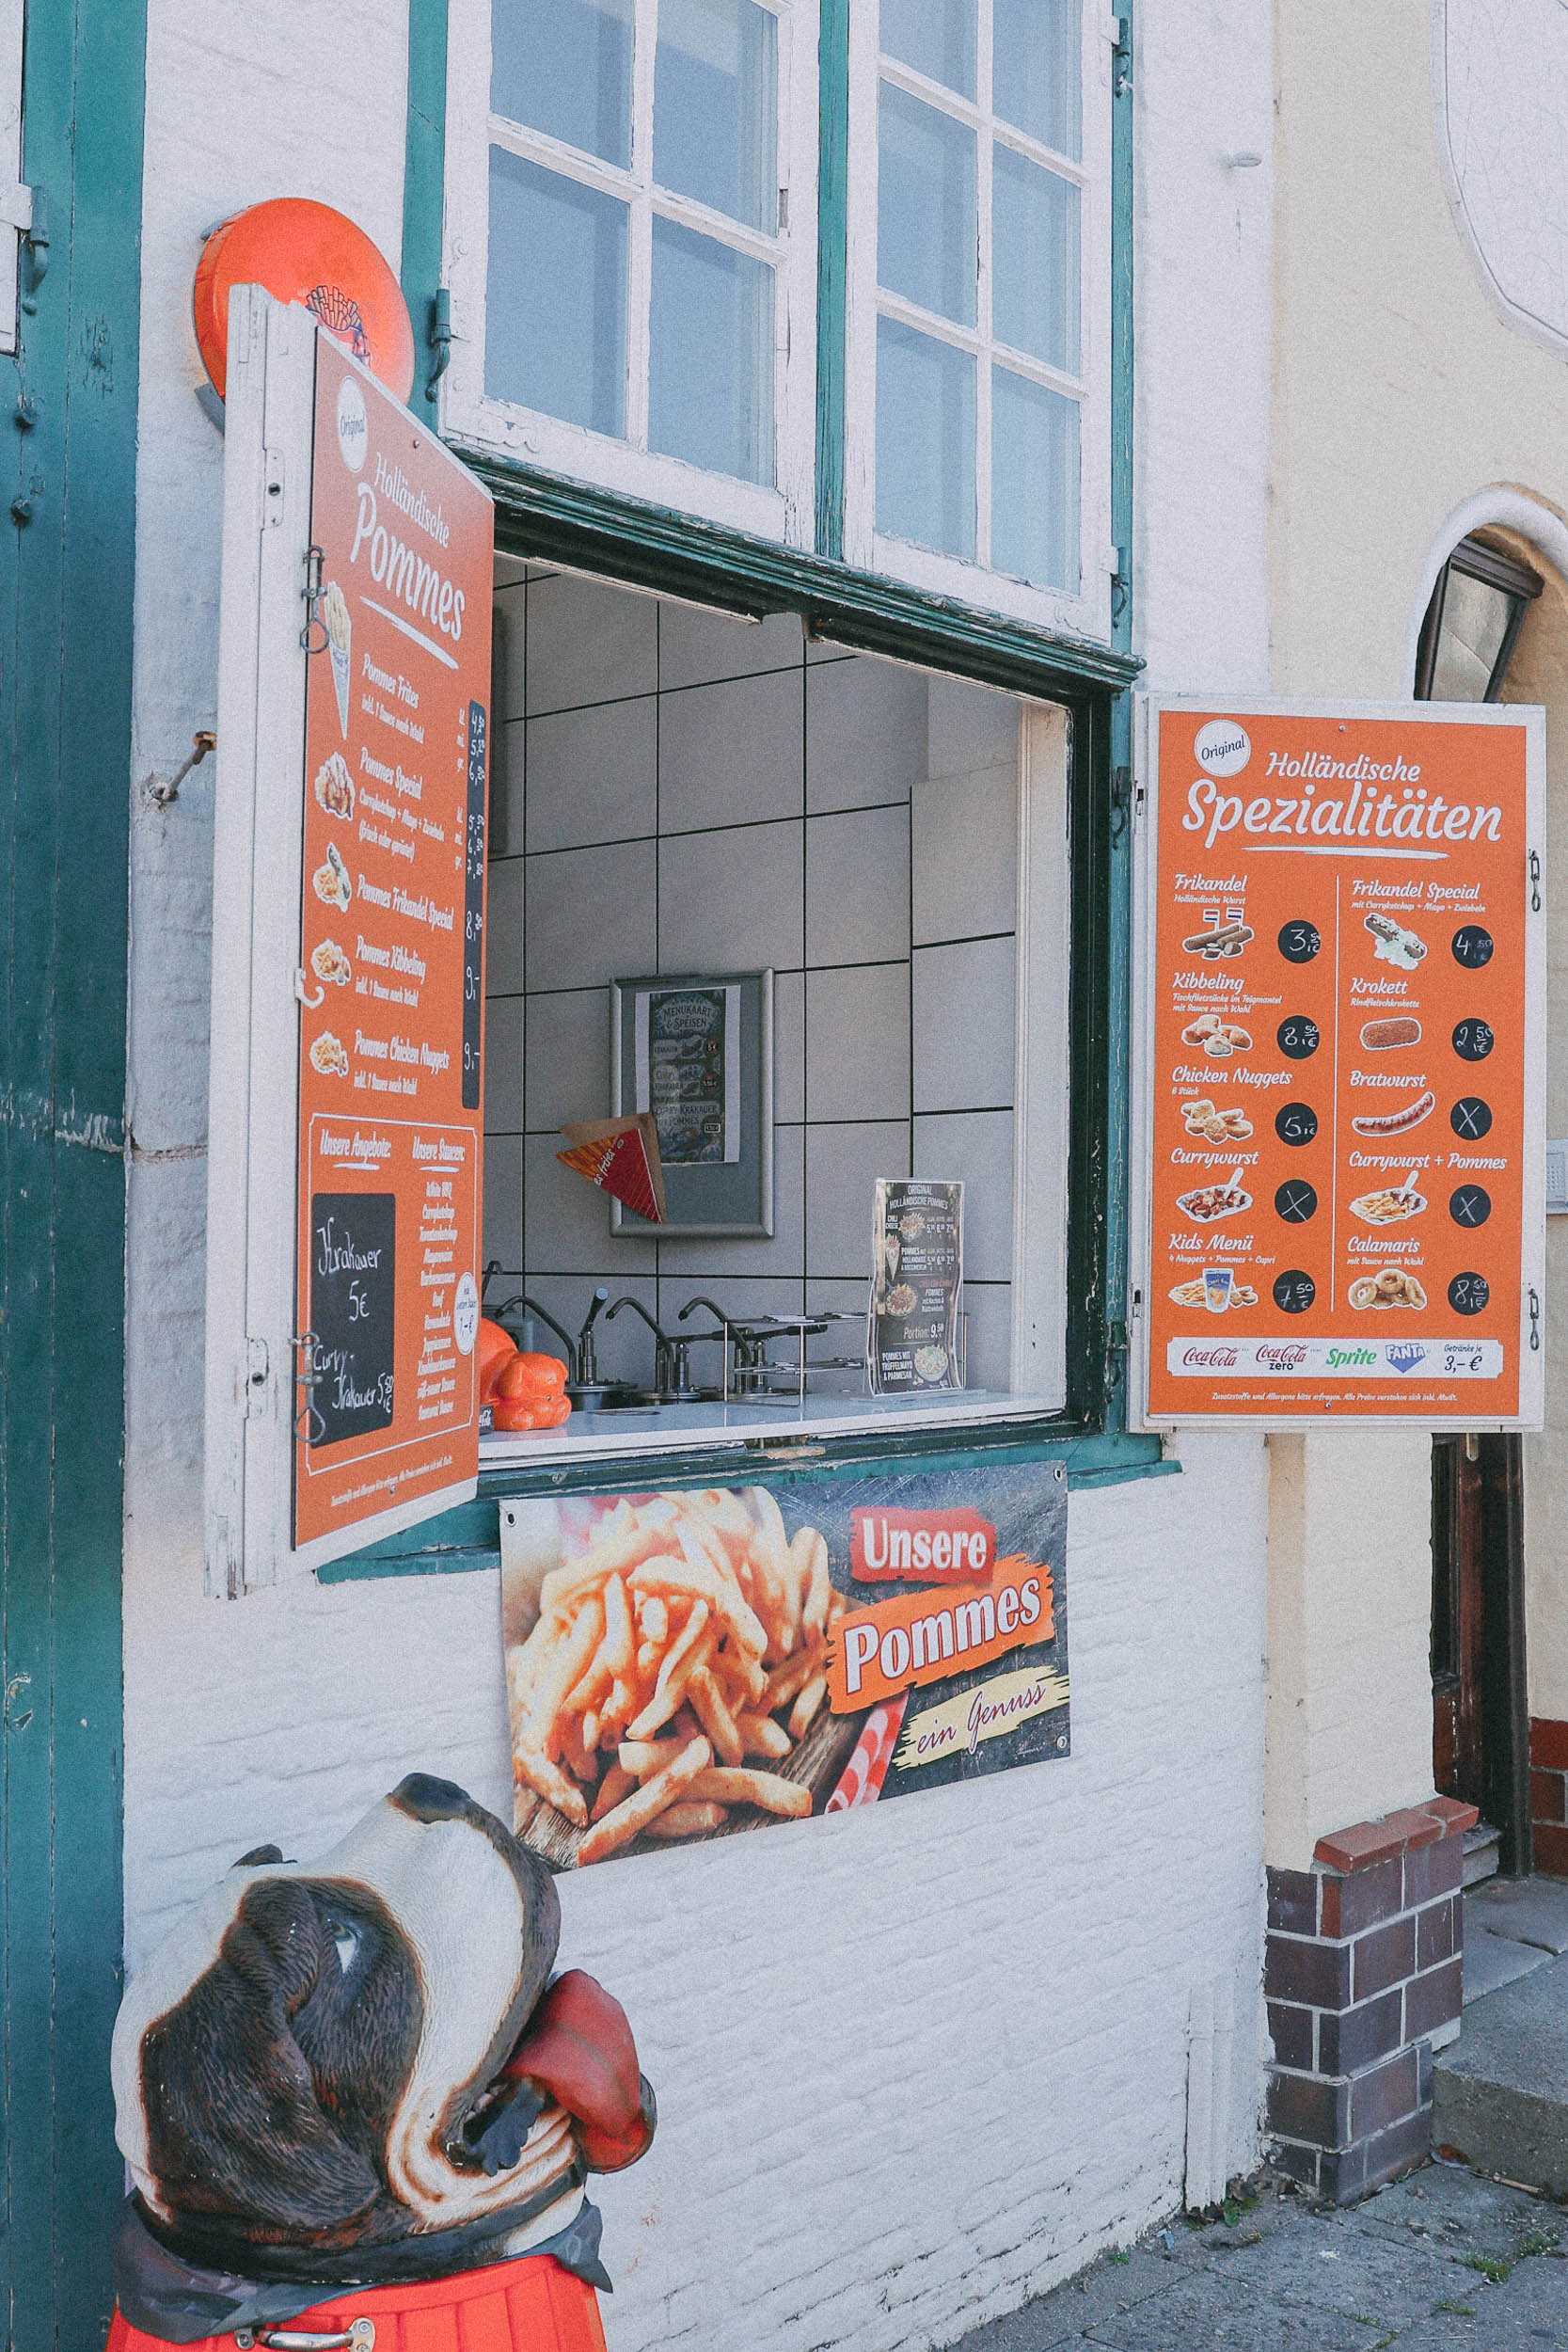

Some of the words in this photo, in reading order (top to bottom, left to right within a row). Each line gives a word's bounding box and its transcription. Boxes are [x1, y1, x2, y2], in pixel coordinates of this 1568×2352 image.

[374, 452, 450, 548] Holländische
[350, 482, 466, 642] Pommes
[361, 652, 396, 694] Pommes
[397, 675, 420, 708] Frites
[1200, 735, 1246, 760] Original
[359, 745, 394, 785] Pommes
[395, 765, 422, 800] Special
[1265, 752, 1421, 783] Holländische
[1182, 778, 1502, 850] Spezialitäten
[1175, 873, 1247, 892] Frikandel
[1351, 879, 1424, 898] Frikandel
[1426, 882, 1481, 903] Special
[356, 873, 391, 909] Pommes
[391, 885, 427, 922] Frikandel
[428, 900, 454, 932] Special
[356, 934, 390, 968] Pommes
[390, 945, 426, 985] Kibbeling
[1172, 972, 1244, 994] Kibbeling
[1350, 977, 1408, 994] Krokett
[674, 1018, 706, 1030] SPEISEN
[354, 1028, 388, 1059] Pommes
[389, 1036, 420, 1064] Chicken
[420, 1042, 450, 1075] Nuggets
[1172, 1064, 1228, 1084] Chicken
[1232, 1067, 1292, 1089] Nuggets
[1350, 1070, 1427, 1088] Bratwurst
[1179, 1086, 1199, 1096] Stück
[320, 1128, 350, 1156] Unsere
[412, 1136, 438, 1160] Unsere
[1171, 1147, 1259, 1169] Currywurst
[1349, 1151, 1430, 1172] Currywurst
[1433, 1155, 1444, 1166] +
[1447, 1152, 1507, 1169] Pommes
[316, 1216, 382, 1277] Krakauer
[1168, 1233, 1203, 1250] Kids
[1206, 1234, 1254, 1250] Menü
[1347, 1234, 1420, 1253] Calamaris
[1176, 1255, 1206, 1264] Nuggets
[1215, 1255, 1246, 1263] Pommes
[1255, 1255, 1276, 1264] Capri
[1325, 1347, 1377, 1369] Sprite
[1386, 1343, 1425, 1360] FANTA
[1444, 1344, 1474, 1353] Getränke
[1475, 1345, 1482, 1355] je
[1270, 1362, 1294, 1371] zero
[1469, 1356, 1482, 1372] €
[332, 1375, 376, 1409] Krakauer
[862, 1518, 988, 1569] Unsere
[844, 1576, 1041, 1694] Pommes
[916, 1721, 958, 1755] ein
[965, 1682, 1048, 1755] Genuss
